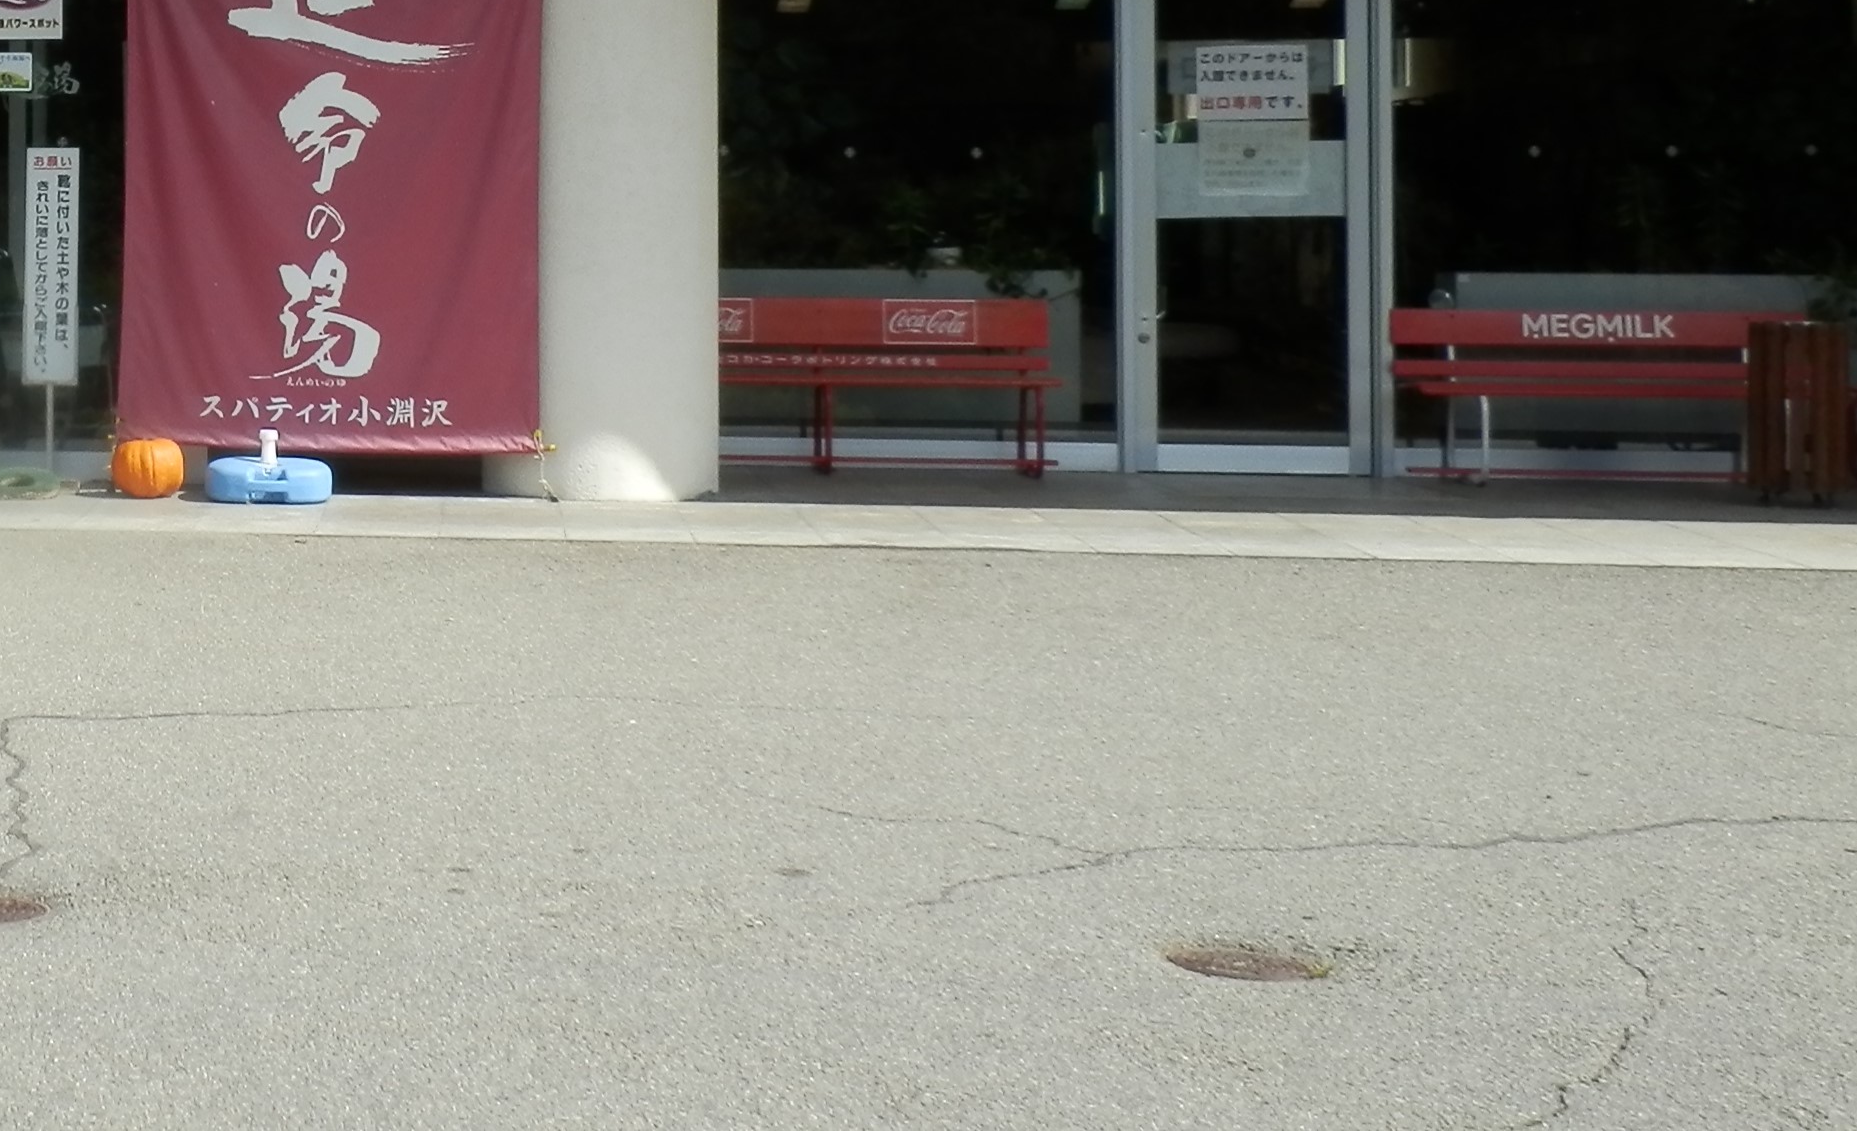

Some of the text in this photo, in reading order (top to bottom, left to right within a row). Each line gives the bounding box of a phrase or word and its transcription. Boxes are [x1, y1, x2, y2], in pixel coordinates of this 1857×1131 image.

[1200, 52, 1304, 64] このドアーからは
[1200, 96, 1303, 110] 出口専用です。
[33, 155, 72, 167] お願い
[1521, 313, 1676, 340] MEGMILK
[286, 379, 347, 387] えんめいのゆ
[199, 395, 453, 428] スパティオ小淵沢
